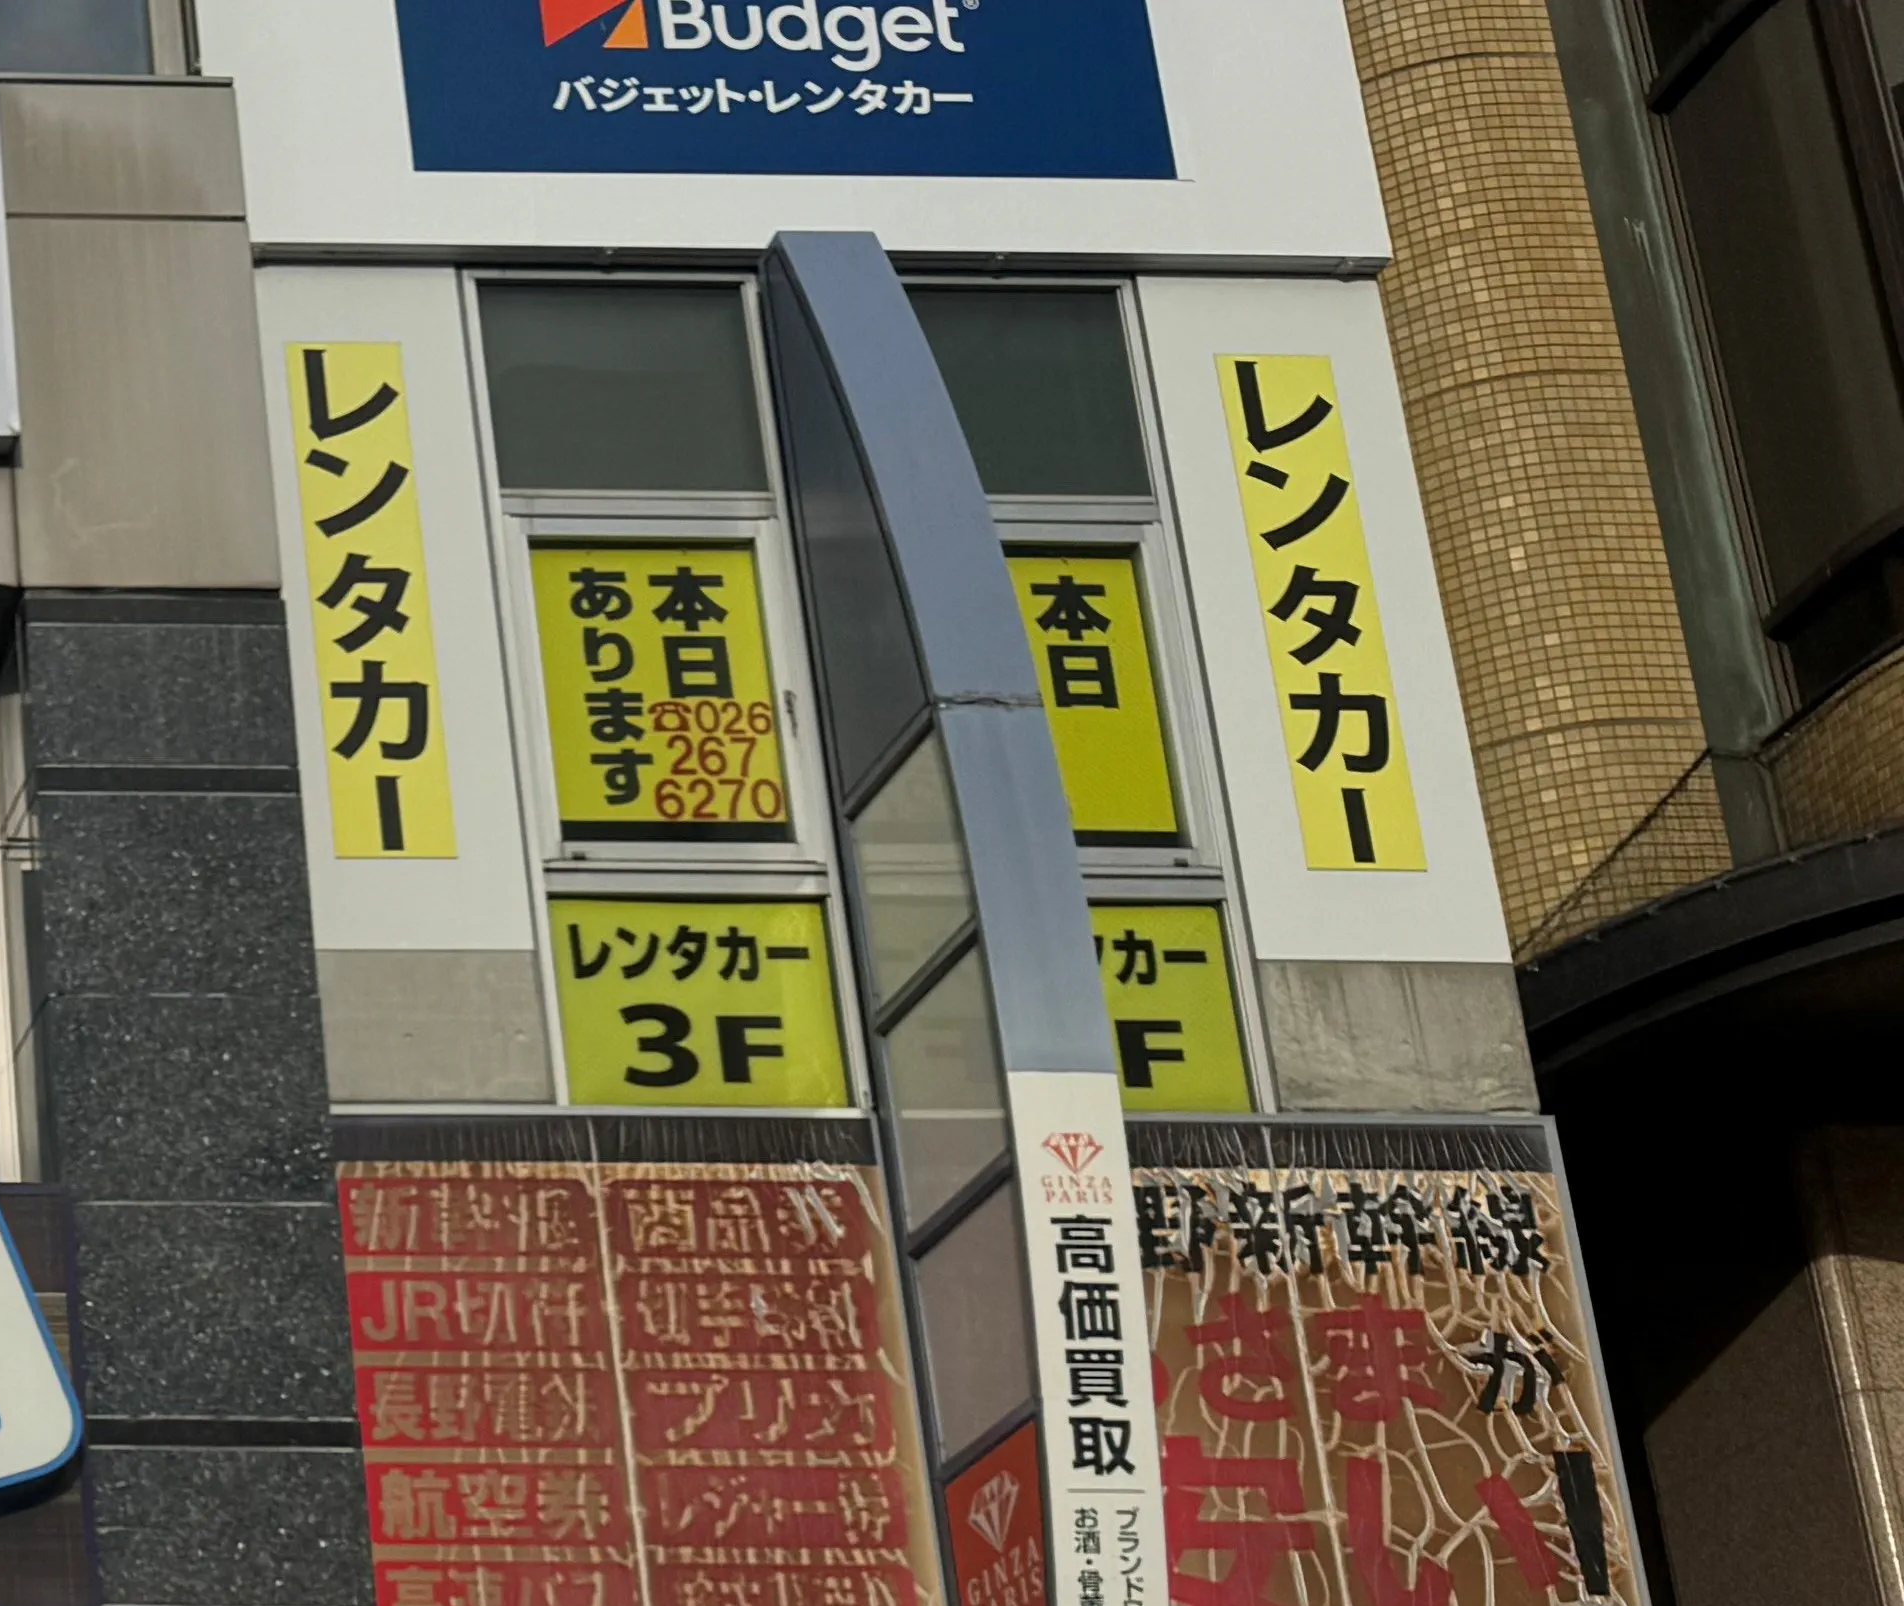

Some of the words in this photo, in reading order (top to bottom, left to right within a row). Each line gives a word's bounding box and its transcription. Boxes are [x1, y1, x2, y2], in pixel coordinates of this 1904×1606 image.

[553, 75, 974, 116] バジェット・レンタカー
[302, 347, 430, 852] レンタカー
[651, 564, 733, 700] 本日
[1234, 359, 1393, 865] レンタカー
[1030, 575, 1120, 711] 本日
[568, 567, 654, 804] あります
[693, 698, 773, 737] 026
[668, 736, 758, 777] 267
[653, 776, 785, 822] 6270
[566, 922, 810, 982] レンタカー
[1090, 930, 1210, 986] カー
[620, 1002, 787, 1088] 3F
[1114, 1018, 1188, 1090] F
[1040, 1174, 1113, 1191] GINZA
[1043, 1189, 1114, 1205] PARIS
[1137, 1182, 1551, 1277] 野新幹線
[360, 1279, 585, 1349] JR切符
[1049, 1213, 1137, 1477] 高価買取
[379, 1469, 611, 1541] 航空券
[967, 1547, 1042, 1605] GINZA
